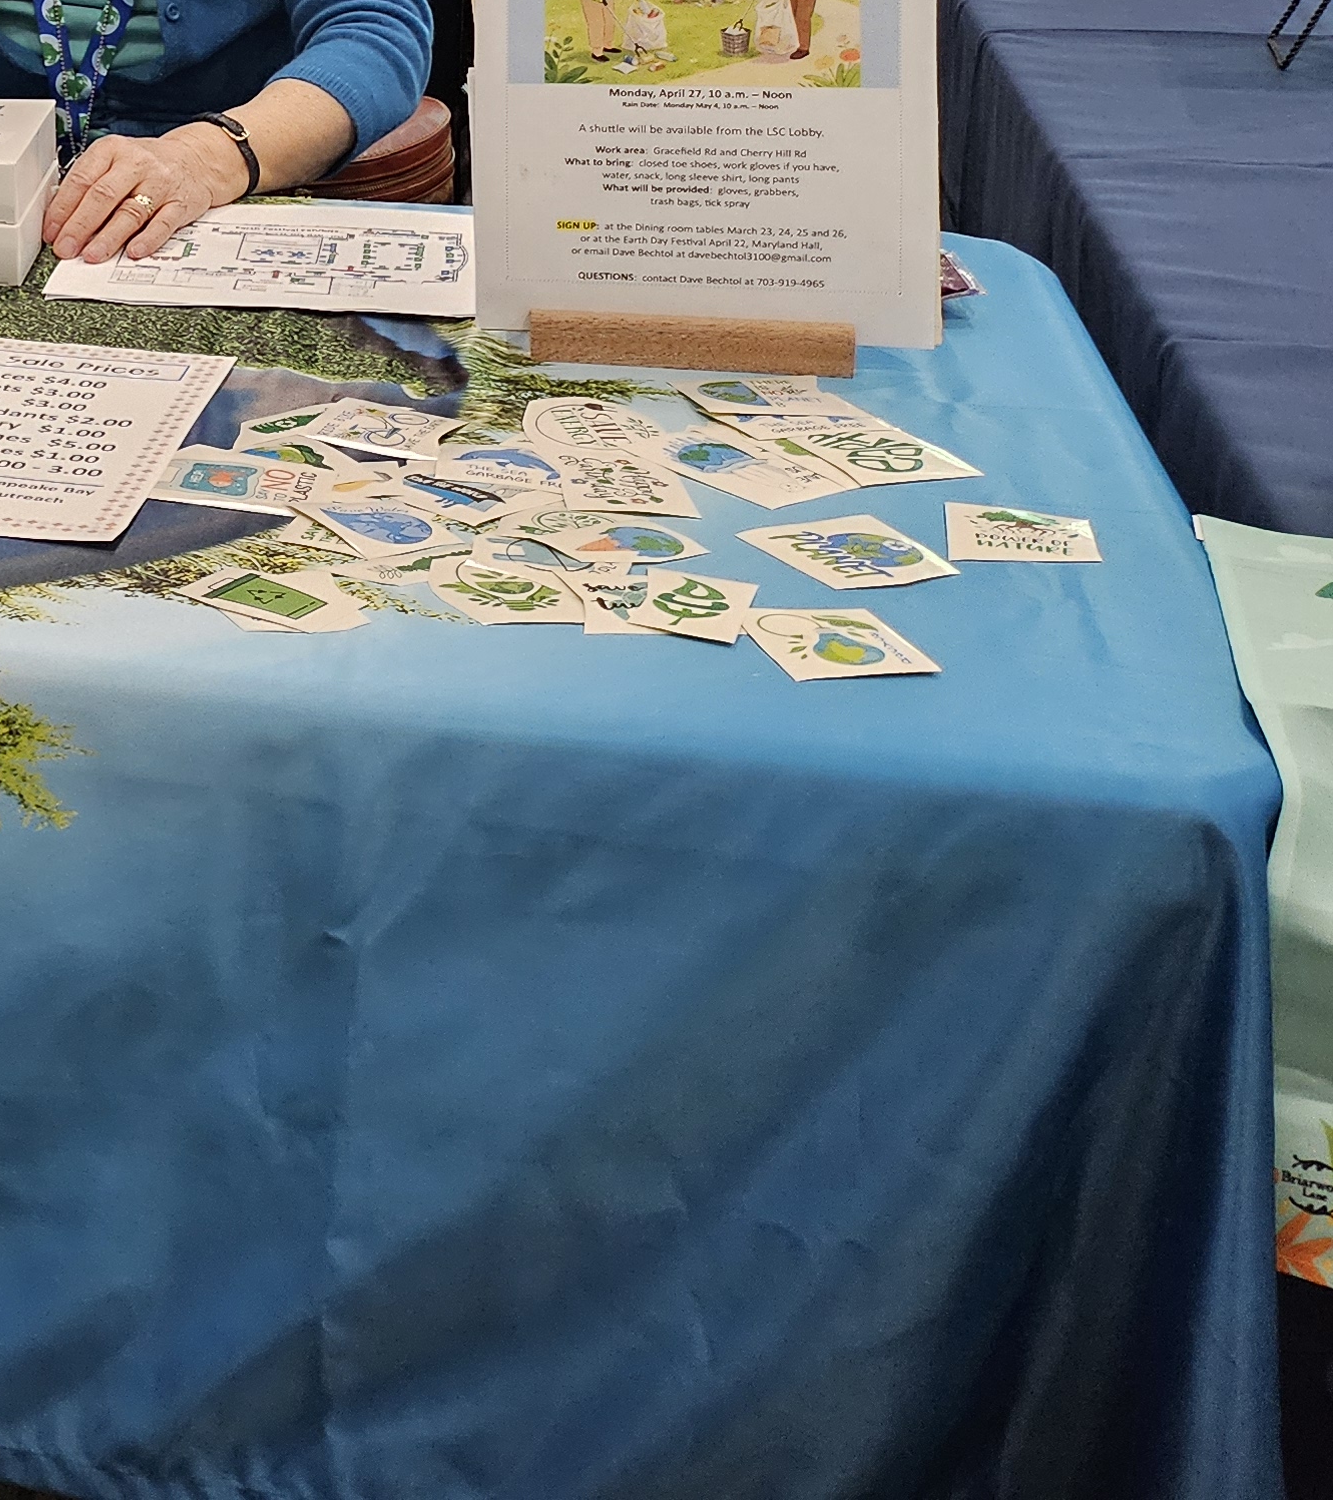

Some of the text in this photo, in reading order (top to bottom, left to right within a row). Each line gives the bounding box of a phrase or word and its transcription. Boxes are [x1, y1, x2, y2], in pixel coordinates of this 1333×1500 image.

[609, 88, 656, 99] Monday,
[659, 89, 685, 100] April
[688, 89, 705, 100] 27,
[708, 89, 722, 99] 10
[724, 91, 749, 99] a.m.
[762, 90, 793, 100] Noon
[578, 123, 824, 139] A shuttle will be available from the LSC Lobby.
[595, 145, 807, 159] Work area: Gracefield Rd and Cherry Hill Rd
[583, 247, 610, 256] email
[612, 247, 636, 257] Dave
[638, 248, 674, 258] Bechtol
[676, 251, 686, 259] at
[687, 250, 832, 263] davebechtol3100@gmail.com
[578, 271, 826, 289] QUESTIONS: contact Dave Bechtol at 703-919-4965
[42, 376, 107, 389] $4.00
[30, 386, 96, 400] $3.00
[21, 398, 87, 412] $3.00
[38, 424, 106, 438] $1.00
[47, 438, 117, 452] $5.00
[466, 463, 527, 477] THE SEA
[466, 469, 533, 485] GARBAGE
[261, 468, 296, 493] NO
[975, 532, 1041, 545] POWER
[768, 531, 895, 579] PLANET
[976, 540, 1075, 557] NATURE
